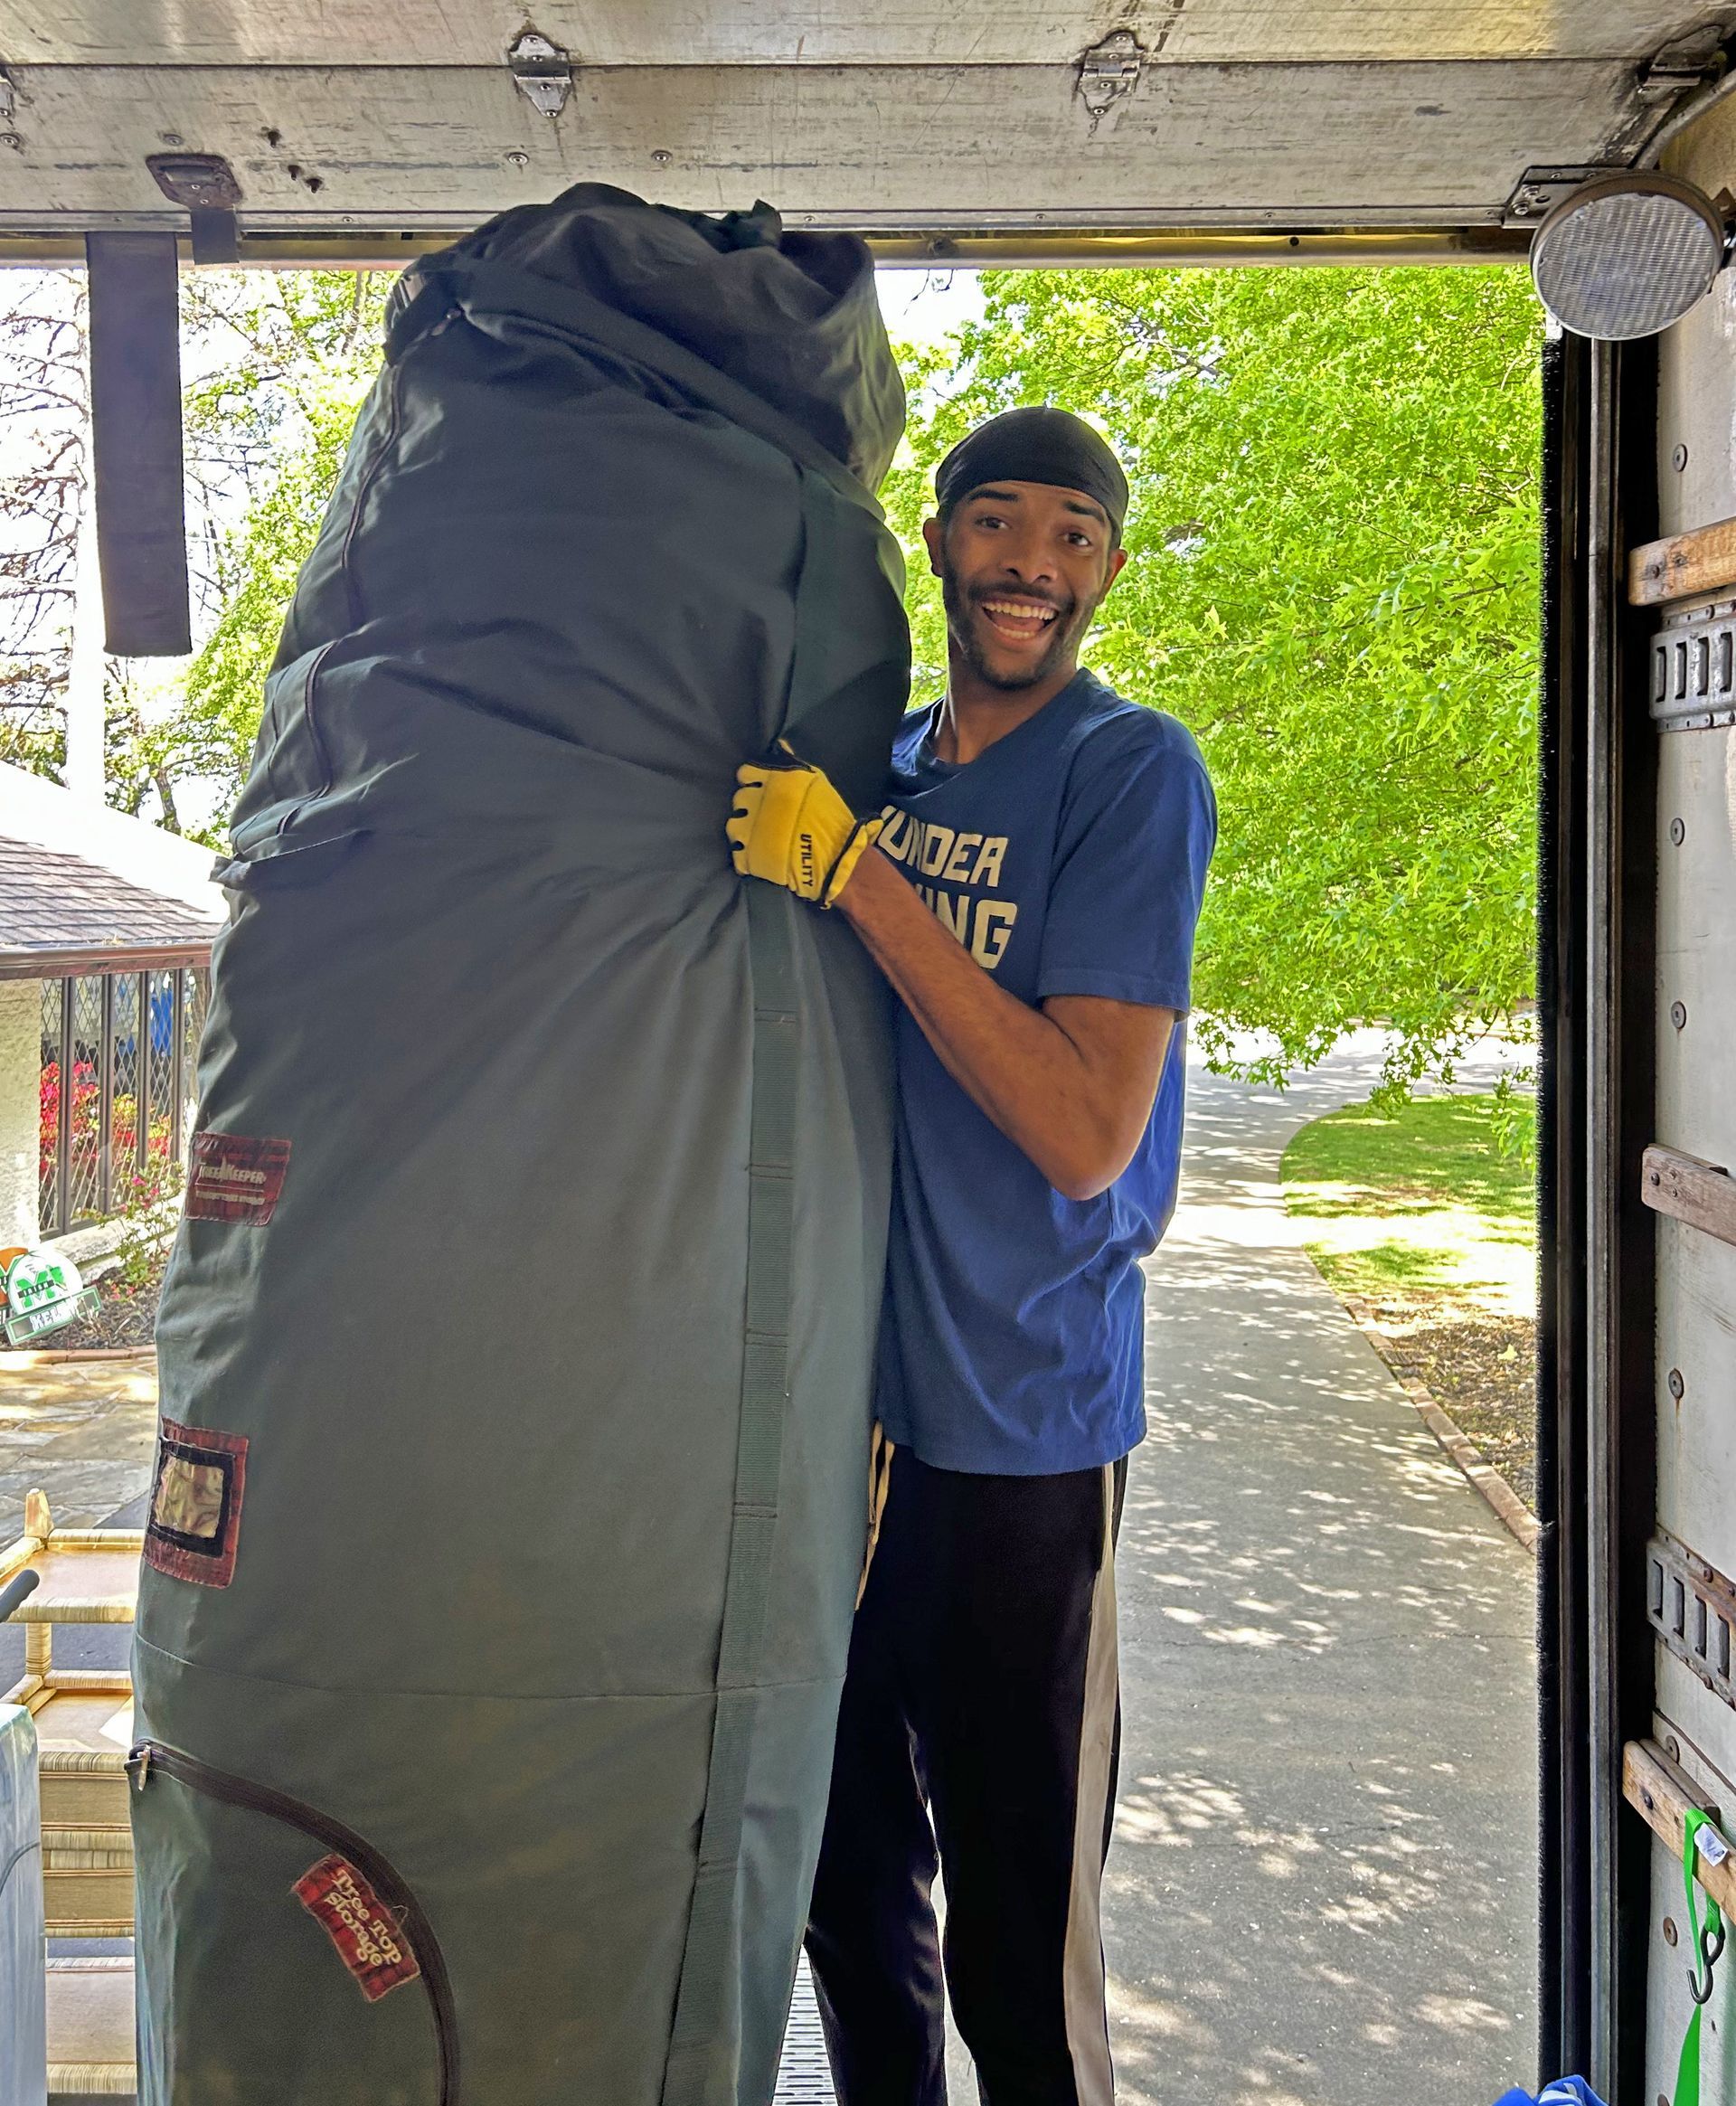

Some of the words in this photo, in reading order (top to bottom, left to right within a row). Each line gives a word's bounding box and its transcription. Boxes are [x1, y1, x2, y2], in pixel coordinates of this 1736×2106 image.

[799, 833, 813, 887] UTILITY
[331, 1869, 370, 1921] Tree
[368, 1920, 402, 1965] Top
